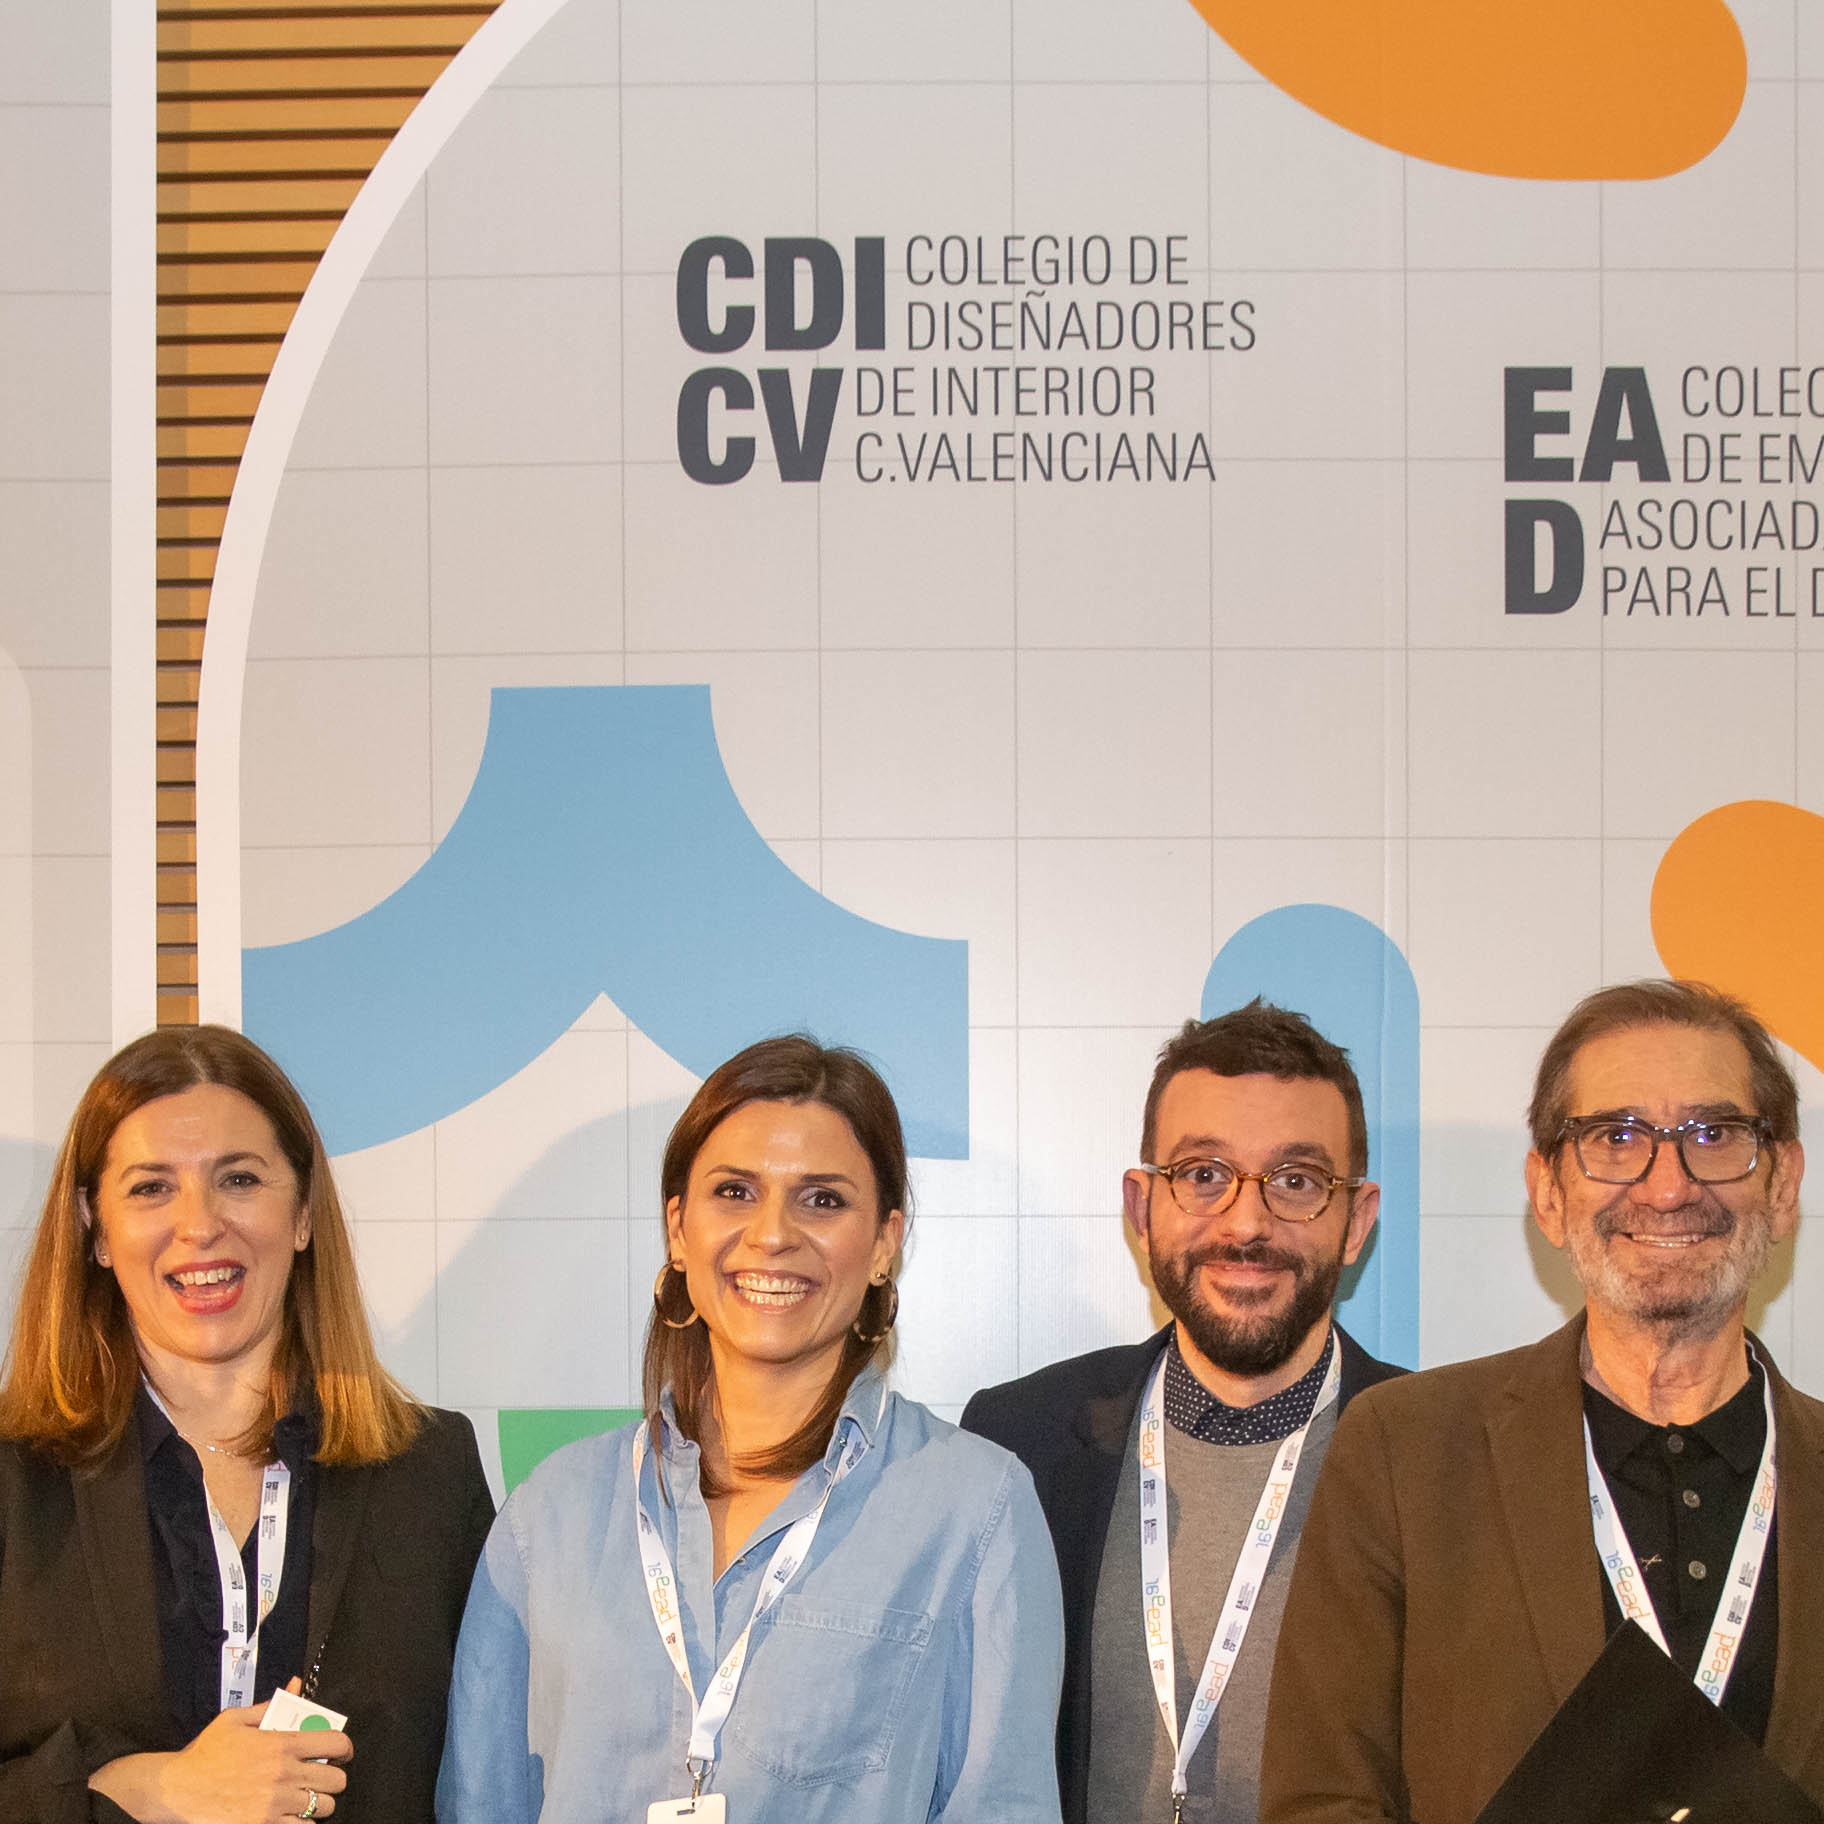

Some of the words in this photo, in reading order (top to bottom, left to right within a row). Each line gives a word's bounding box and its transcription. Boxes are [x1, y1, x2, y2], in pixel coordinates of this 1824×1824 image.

[676, 236, 886, 354] CDI
[905, 235, 1112, 286] COLEGIO
[1129, 236, 1189, 285] DE
[907, 289, 1257, 351] DISEÑADORES
[676, 367, 845, 485] CV
[856, 367, 917, 416] DE
[932, 367, 1156, 416] INTERIOR
[855, 432, 1217, 483] C.VALENCIANA
[1503, 366, 1672, 483] EA
[1682, 434, 1743, 484] DE
[1503, 498, 1586, 615] D
[1602, 566, 1731, 617] PARA
[1745, 566, 1797, 617] EL
